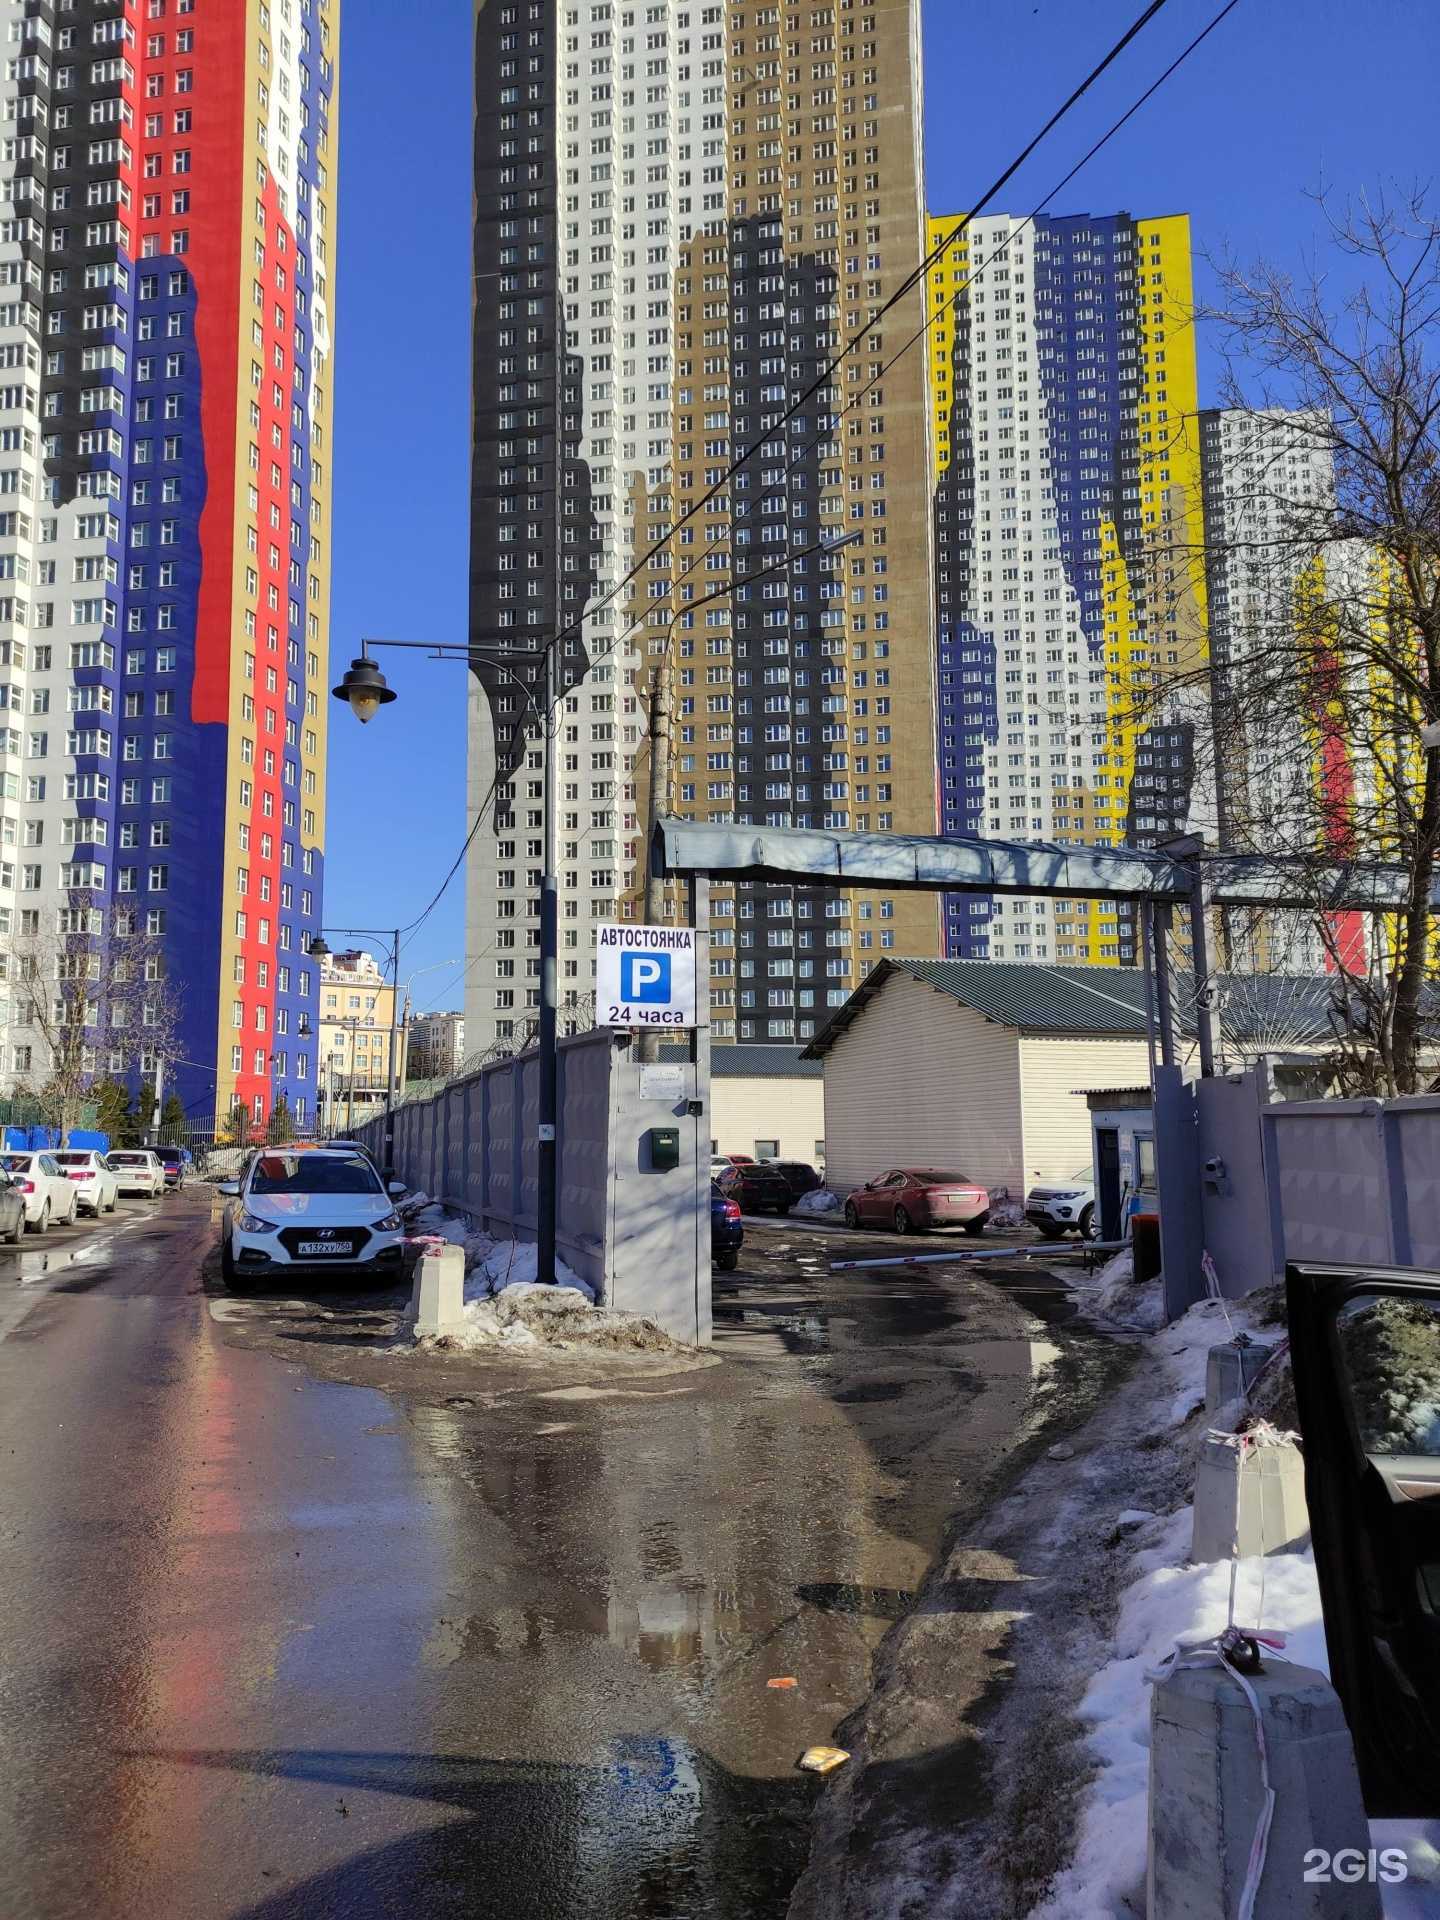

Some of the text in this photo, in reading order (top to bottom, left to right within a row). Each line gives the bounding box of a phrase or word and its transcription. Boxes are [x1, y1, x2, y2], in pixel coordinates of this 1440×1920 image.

[601, 928, 691, 949] АВТОСТОЯНКА
[632, 959, 661, 997] P
[609, 1006, 684, 1023] 24 часа
